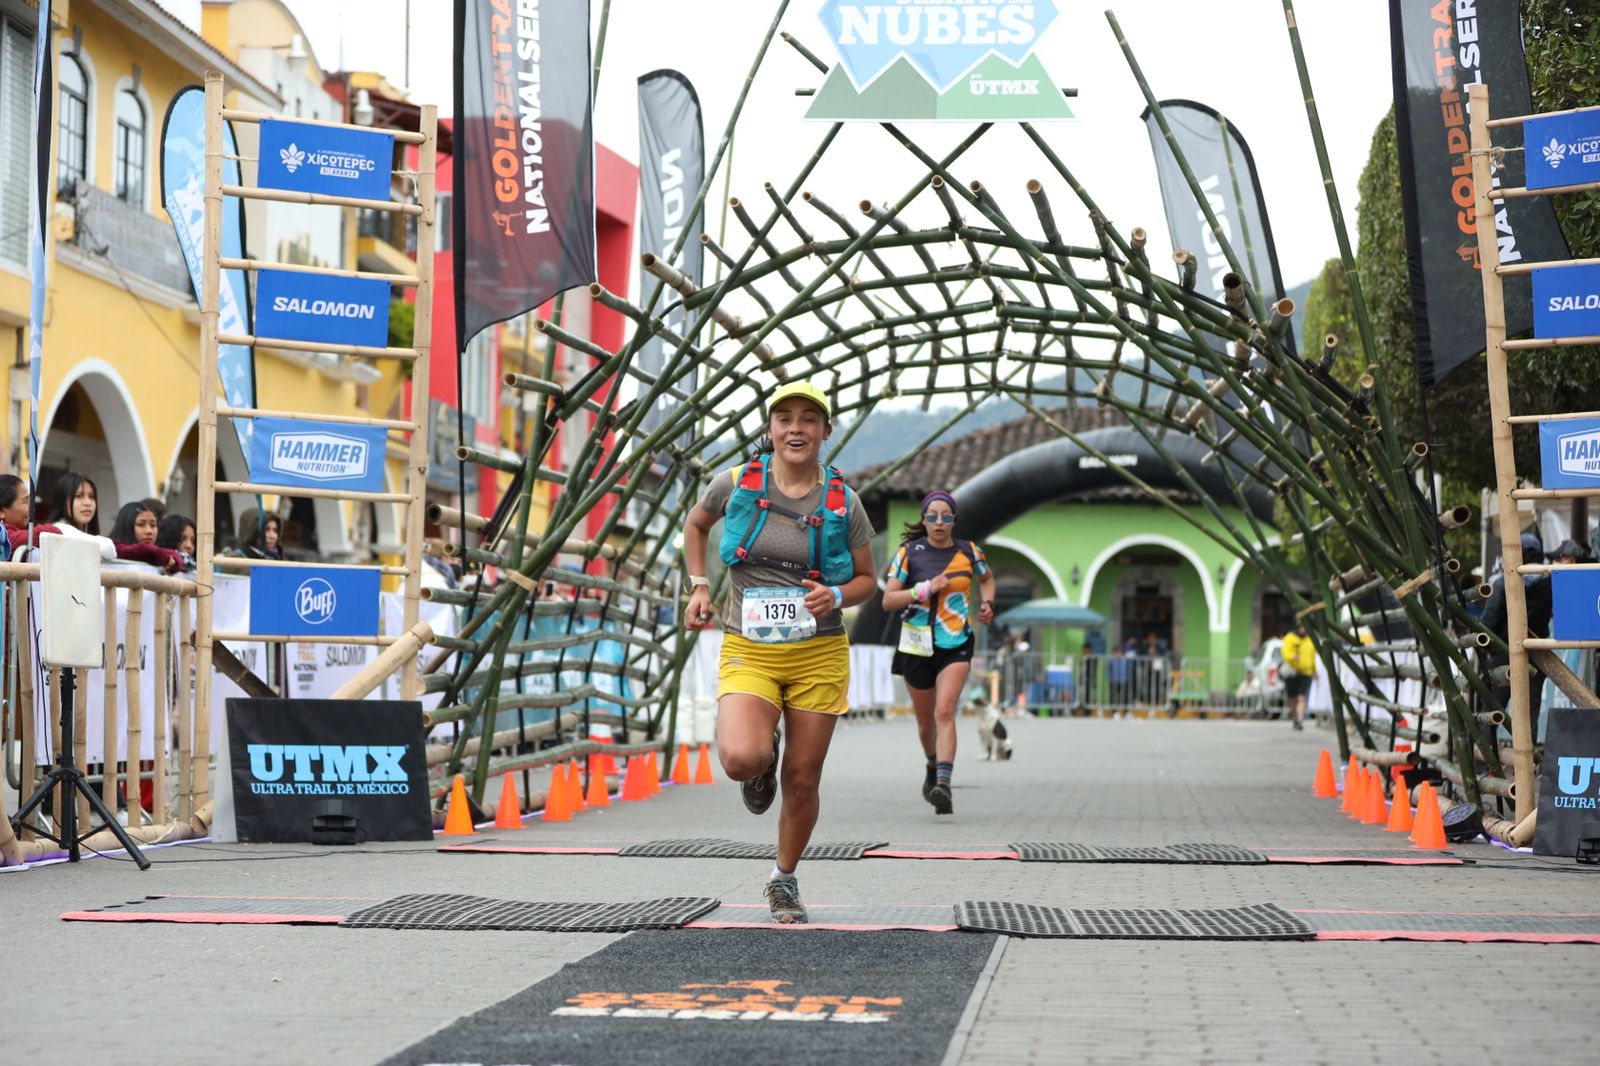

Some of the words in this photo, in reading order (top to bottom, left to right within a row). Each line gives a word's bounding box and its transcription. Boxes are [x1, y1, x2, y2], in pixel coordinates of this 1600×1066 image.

[838, 4, 1036, 45] NUBES
[969, 79, 1040, 96] UTMX
[1568, 141, 1600, 156] XICO
[307, 152, 376, 171] XICOTEPEC
[273, 296, 375, 319] SALOMON
[1549, 295, 1600, 311] SALO
[277, 440, 363, 463] HAMMER
[297, 461, 346, 474] NUTRITION
[764, 603, 796, 620] 1379
[247, 744, 408, 782] UTMX
[1557, 756, 1600, 795] U
[251, 783, 294, 795] ULTRA
[294, 783, 335, 795] TRAIL
[336, 783, 356, 795] DE
[357, 781, 409, 795] MÉXICO
[1554, 796, 1596, 809] ULTRA
